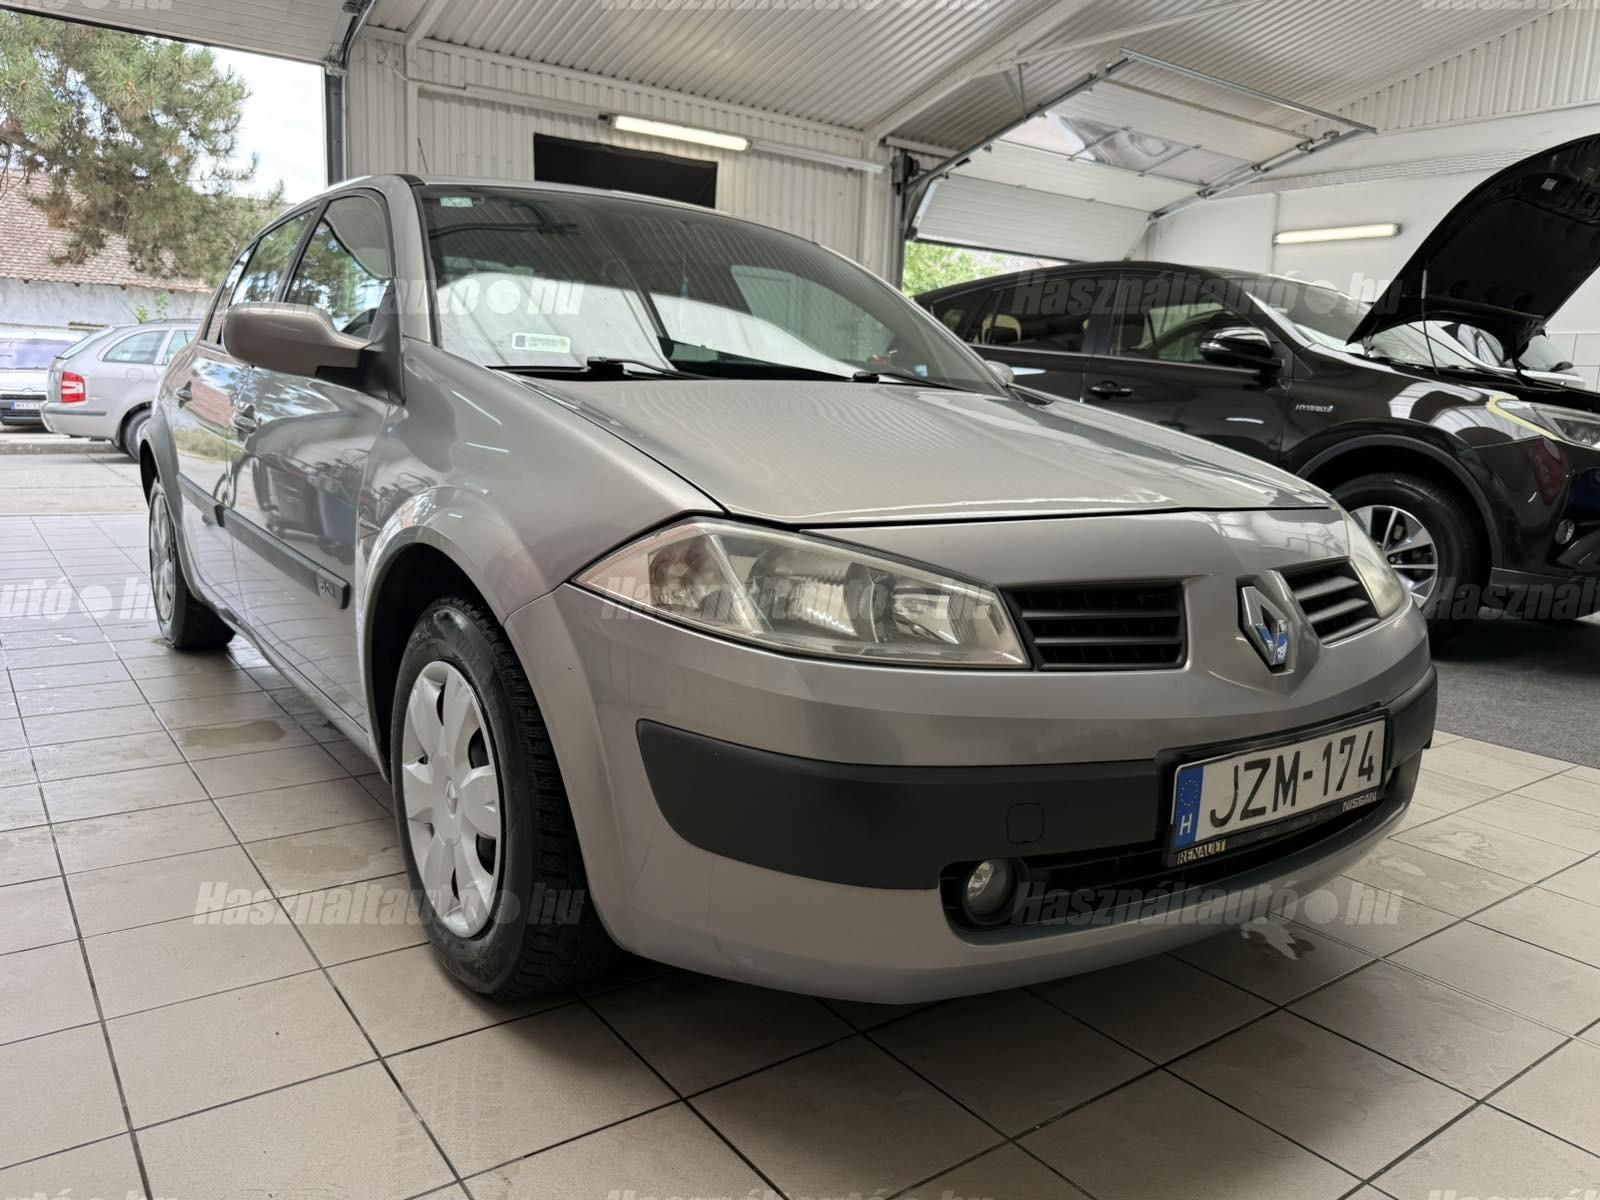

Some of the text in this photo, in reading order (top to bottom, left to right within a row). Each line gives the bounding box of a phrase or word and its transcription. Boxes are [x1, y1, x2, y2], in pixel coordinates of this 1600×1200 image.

[1210, 730, 1374, 828] JZM-174
[1342, 791, 1377, 812] NISSAN
[1179, 813, 1192, 836] H
[1177, 839, 1227, 865] RENAULT
